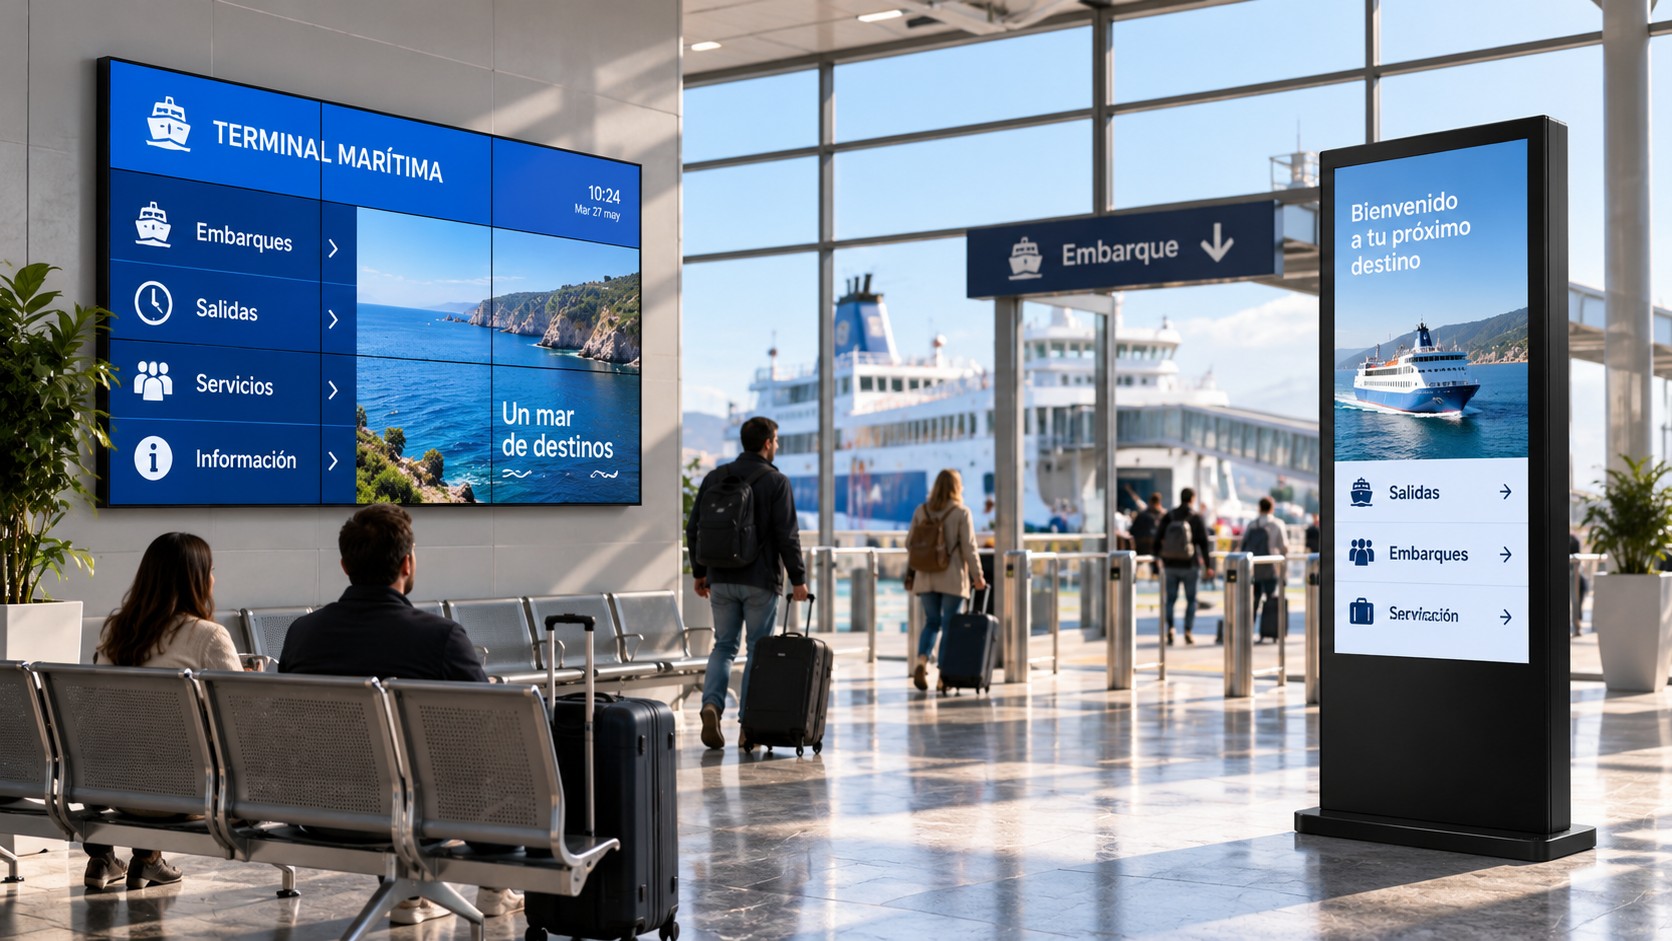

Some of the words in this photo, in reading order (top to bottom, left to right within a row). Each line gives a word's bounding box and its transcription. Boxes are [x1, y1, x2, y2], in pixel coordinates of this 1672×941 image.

[212, 119, 332, 164] TERMINAL
[338, 143, 444, 184] MARÍTIMA
[588, 184, 621, 205] 10:24
[1350, 190, 1459, 223] Bienvenido
[574, 203, 591, 216] Mar
[592, 206, 603, 217] 27
[196, 221, 293, 254] Embarques
[1350, 234, 1362, 250] a
[1366, 228, 1387, 247] tu
[1392, 219, 1471, 245] próximo
[1062, 239, 1179, 266] Embarque
[1351, 252, 1421, 276] destino
[196, 297, 258, 322] Salidas
[196, 373, 274, 396] Servicios
[502, 400, 529, 426] Un
[536, 408, 575, 427] mar
[502, 431, 528, 457] de
[533, 433, 614, 459] destinos
[196, 448, 297, 469] Información
[1389, 484, 1440, 500] Salidas
[1389, 545, 1469, 565] Embarques
